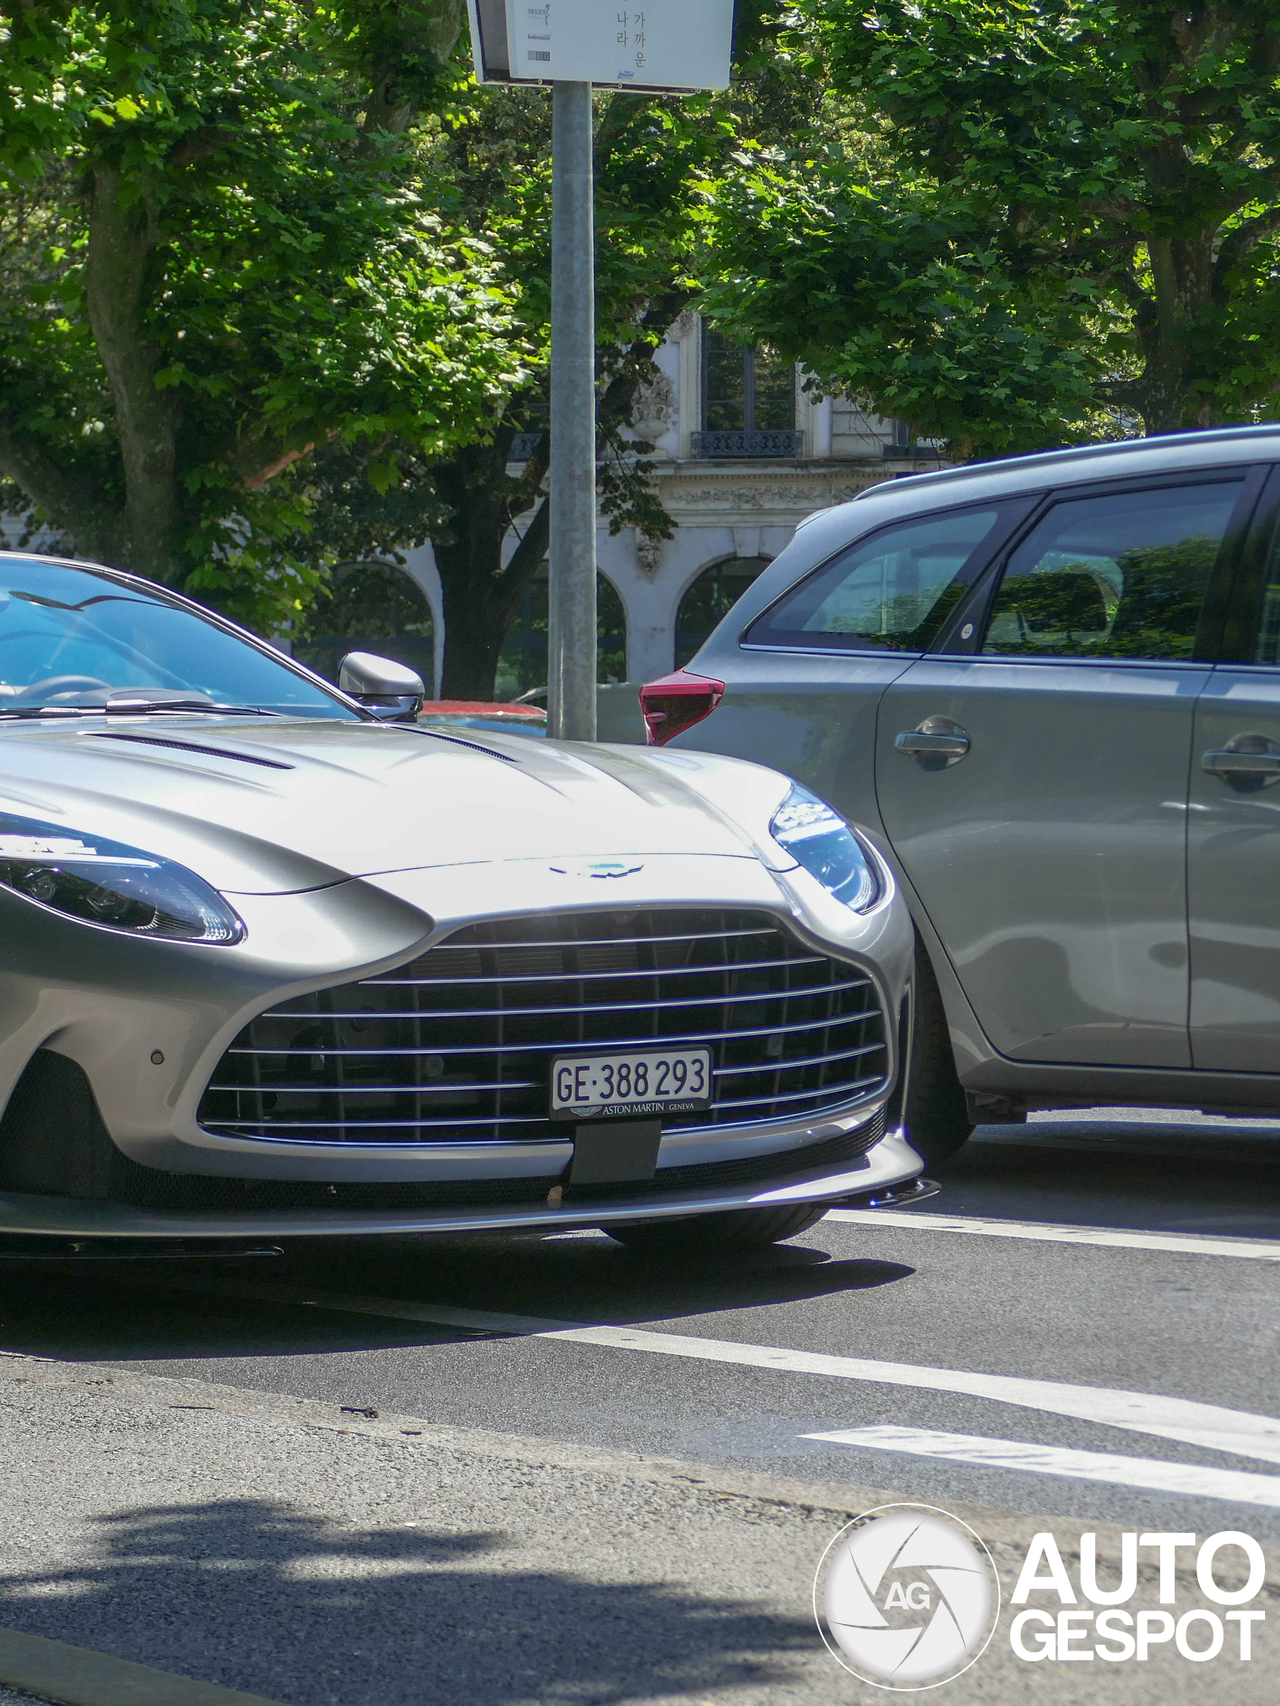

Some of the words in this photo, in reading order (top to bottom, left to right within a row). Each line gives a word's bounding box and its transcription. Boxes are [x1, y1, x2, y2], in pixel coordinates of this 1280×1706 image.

[602, 1104, 631, 1115] ASTON
[632, 1102, 665, 1113] MARTIN
[669, 1102, 695, 1111] GENEVA
